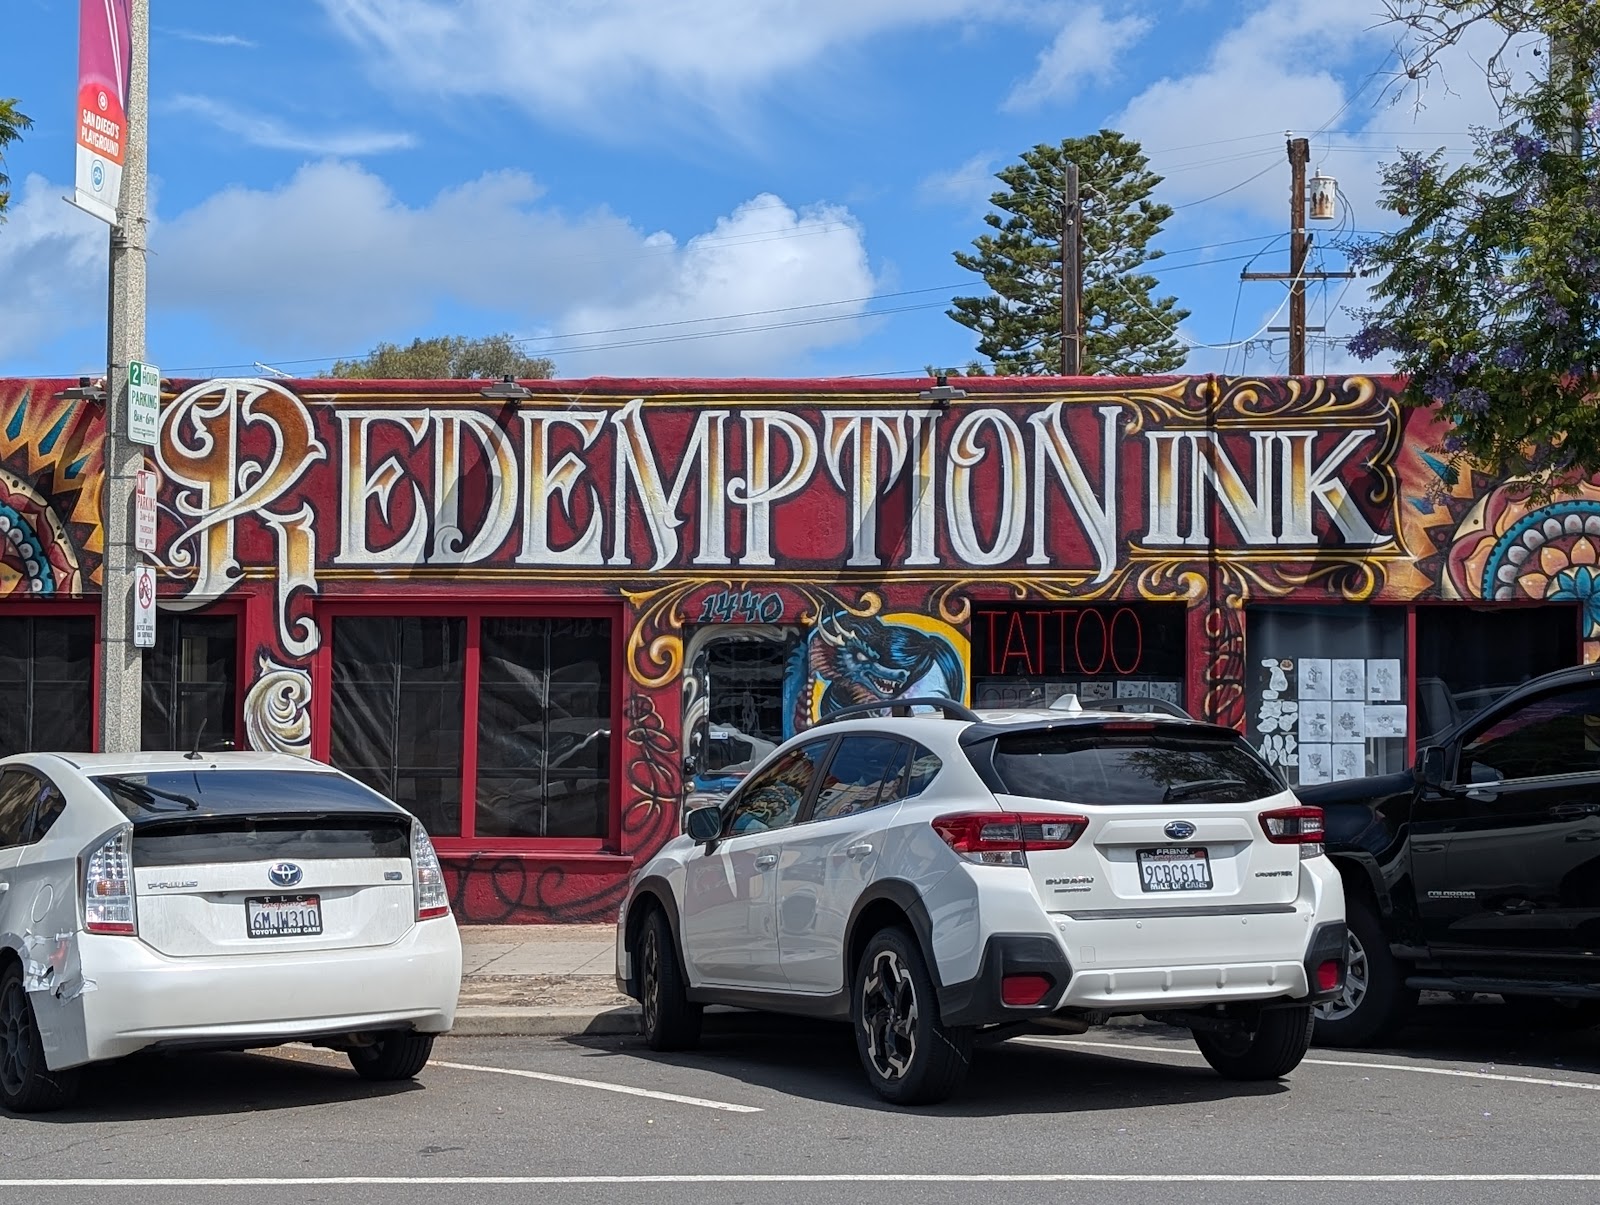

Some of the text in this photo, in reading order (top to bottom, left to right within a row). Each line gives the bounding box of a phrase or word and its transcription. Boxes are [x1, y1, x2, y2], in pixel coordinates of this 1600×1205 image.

[83, 109, 119, 139] SAN DIEGO'S
[81, 125, 119, 157] PLAYGROUND
[132, 364, 158, 387] 2 HOUR
[131, 390, 158, 410] PARKING
[1142, 430, 1393, 545] INK
[137, 495, 155, 512] PARKING
[154, 378, 1122, 656] REDEMPTION
[697, 589, 785, 623] 1440
[977, 607, 1142, 675] TATTOO
[1156, 847, 1189, 855] FRANK
[1045, 877, 1094, 885] SUBARU
[1145, 863, 1206, 884] 9CBC817
[148, 881, 198, 889] PRIUS
[1185, 881, 1208, 889] CARS
[253, 909, 317, 930] 6MJW310
[251, 928, 278, 936] TOYOTA
